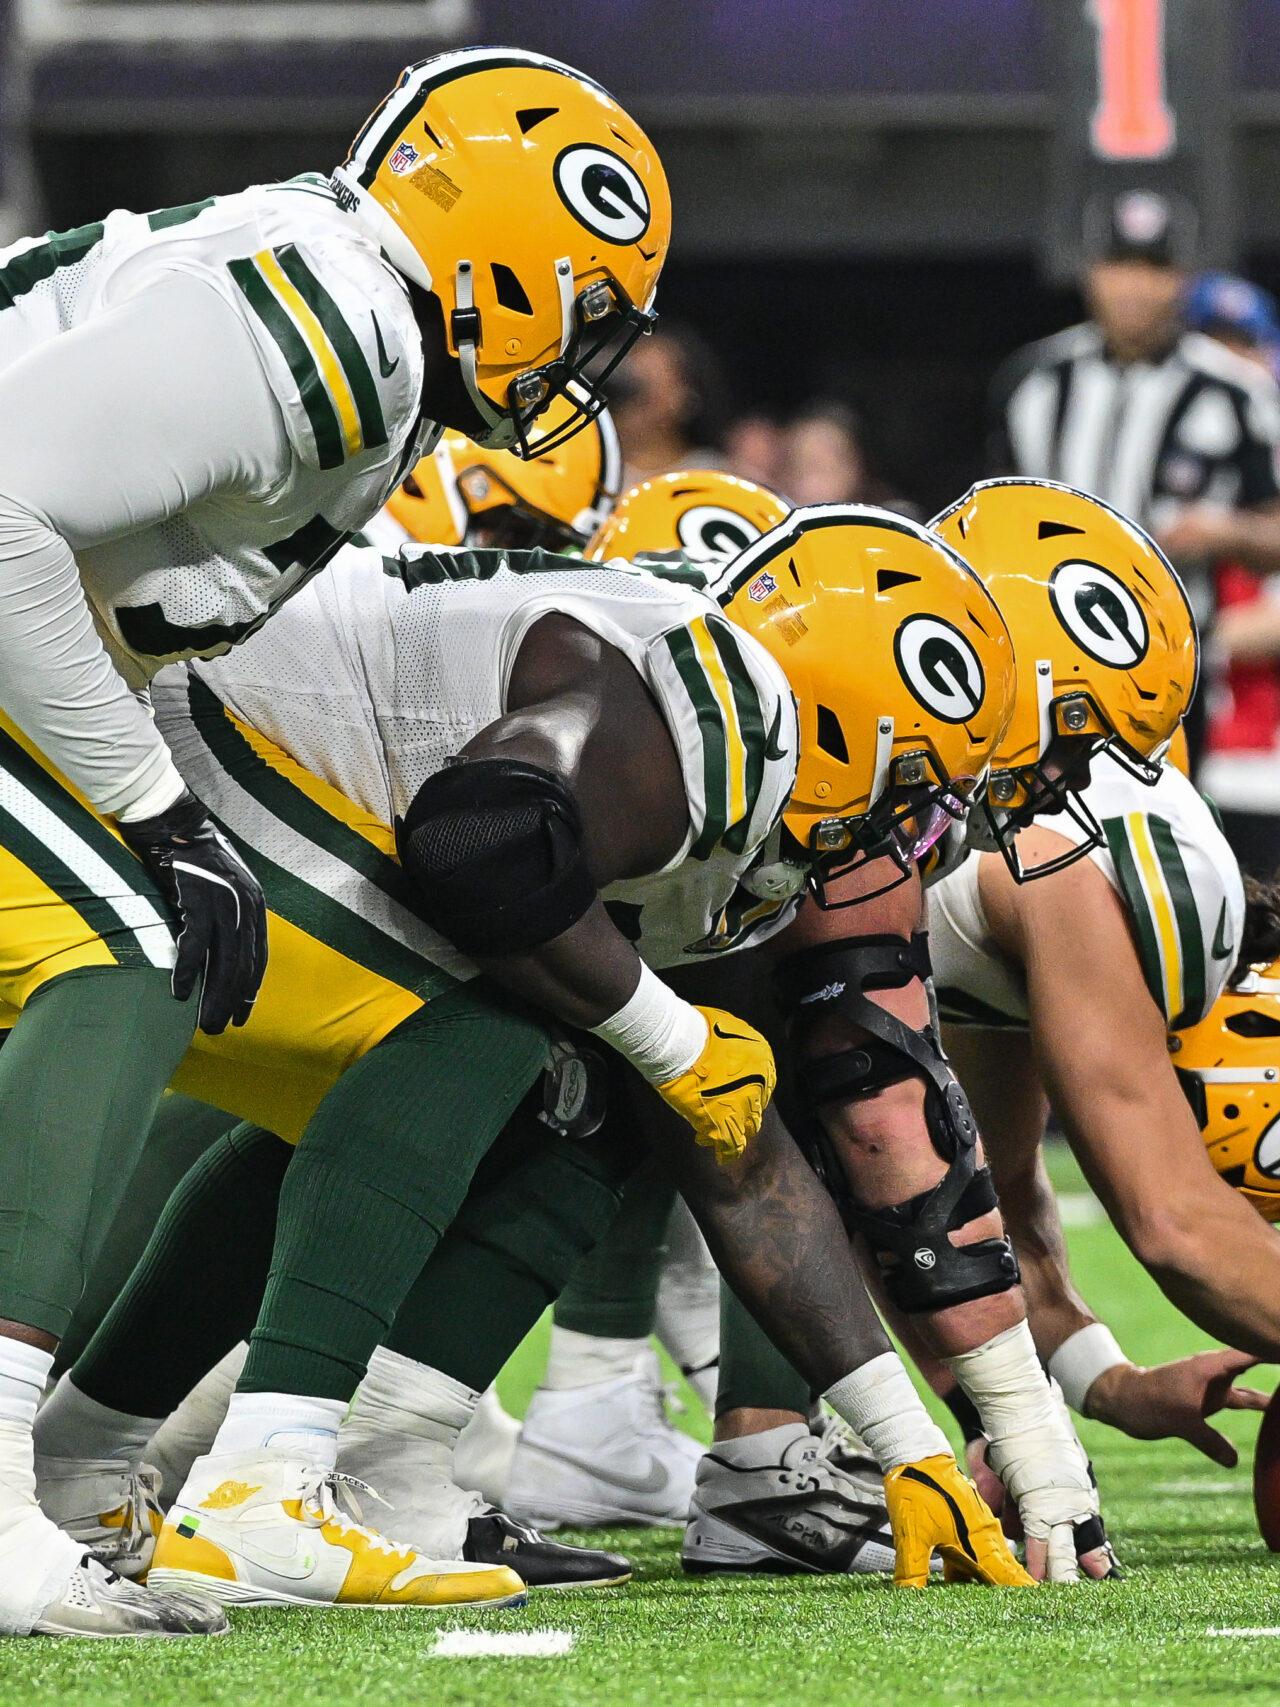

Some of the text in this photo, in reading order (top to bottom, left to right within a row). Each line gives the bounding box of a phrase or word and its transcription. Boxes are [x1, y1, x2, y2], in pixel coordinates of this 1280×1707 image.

[391, 151, 408, 172] NFL
[554, 143, 650, 245] G
[1050, 560, 1148, 668] G
[895, 614, 984, 723] G
